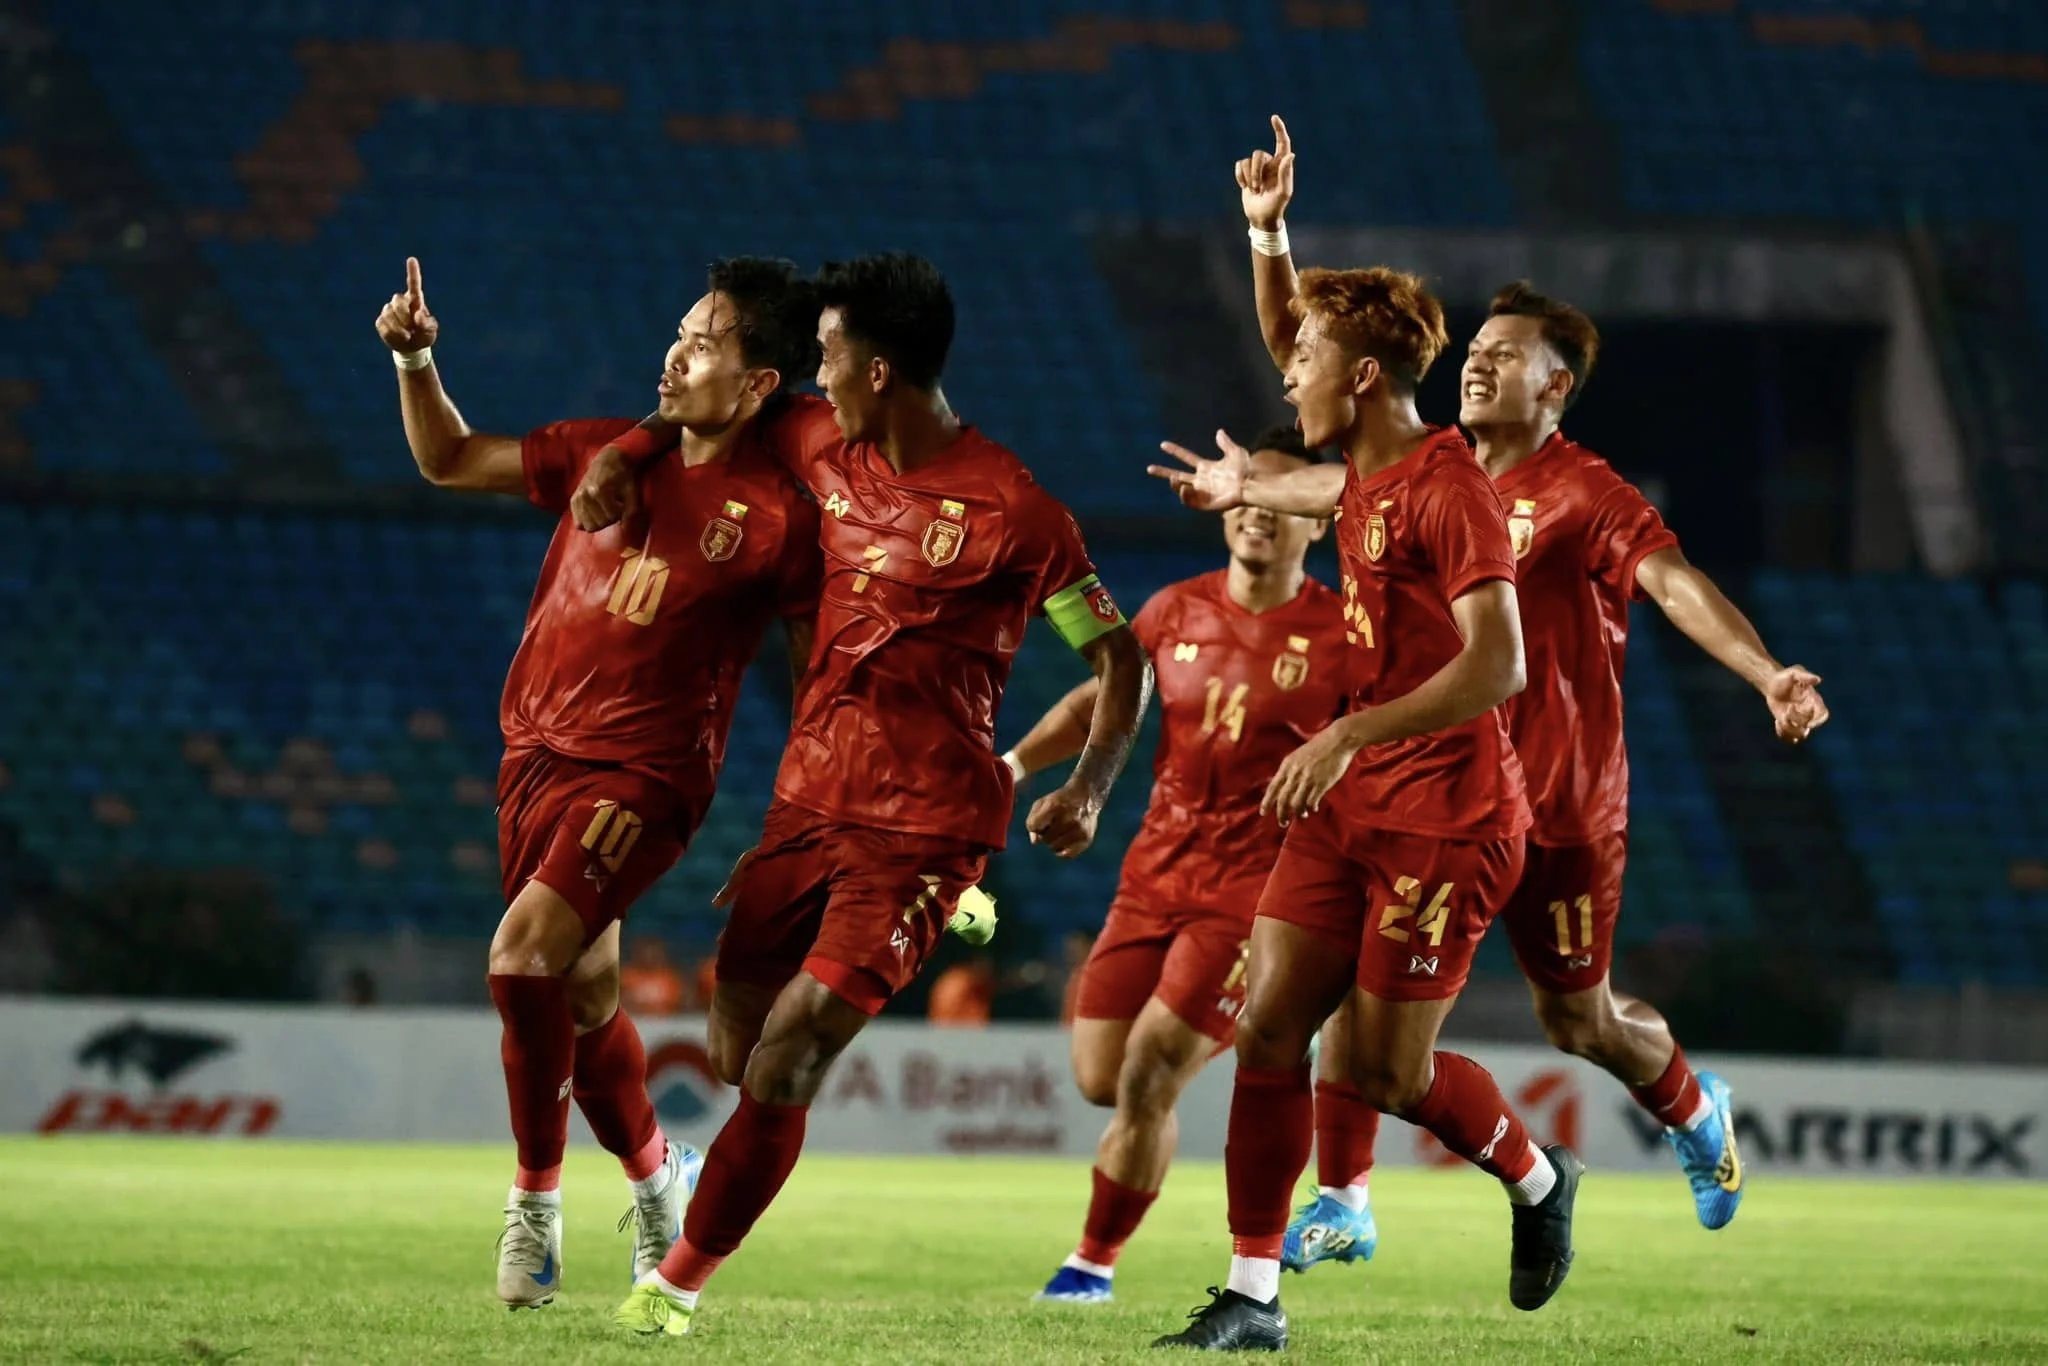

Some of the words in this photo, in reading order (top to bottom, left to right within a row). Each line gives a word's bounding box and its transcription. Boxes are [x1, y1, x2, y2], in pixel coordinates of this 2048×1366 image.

[606, 546, 670, 626] 10
[847, 545, 888, 593] 7
[1202, 677, 1250, 743] 14
[580, 799, 643, 874] 10
[1378, 875, 1455, 946] 24
[1548, 894, 1593, 956] 11
[902, 1050, 1061, 1107] Bank
